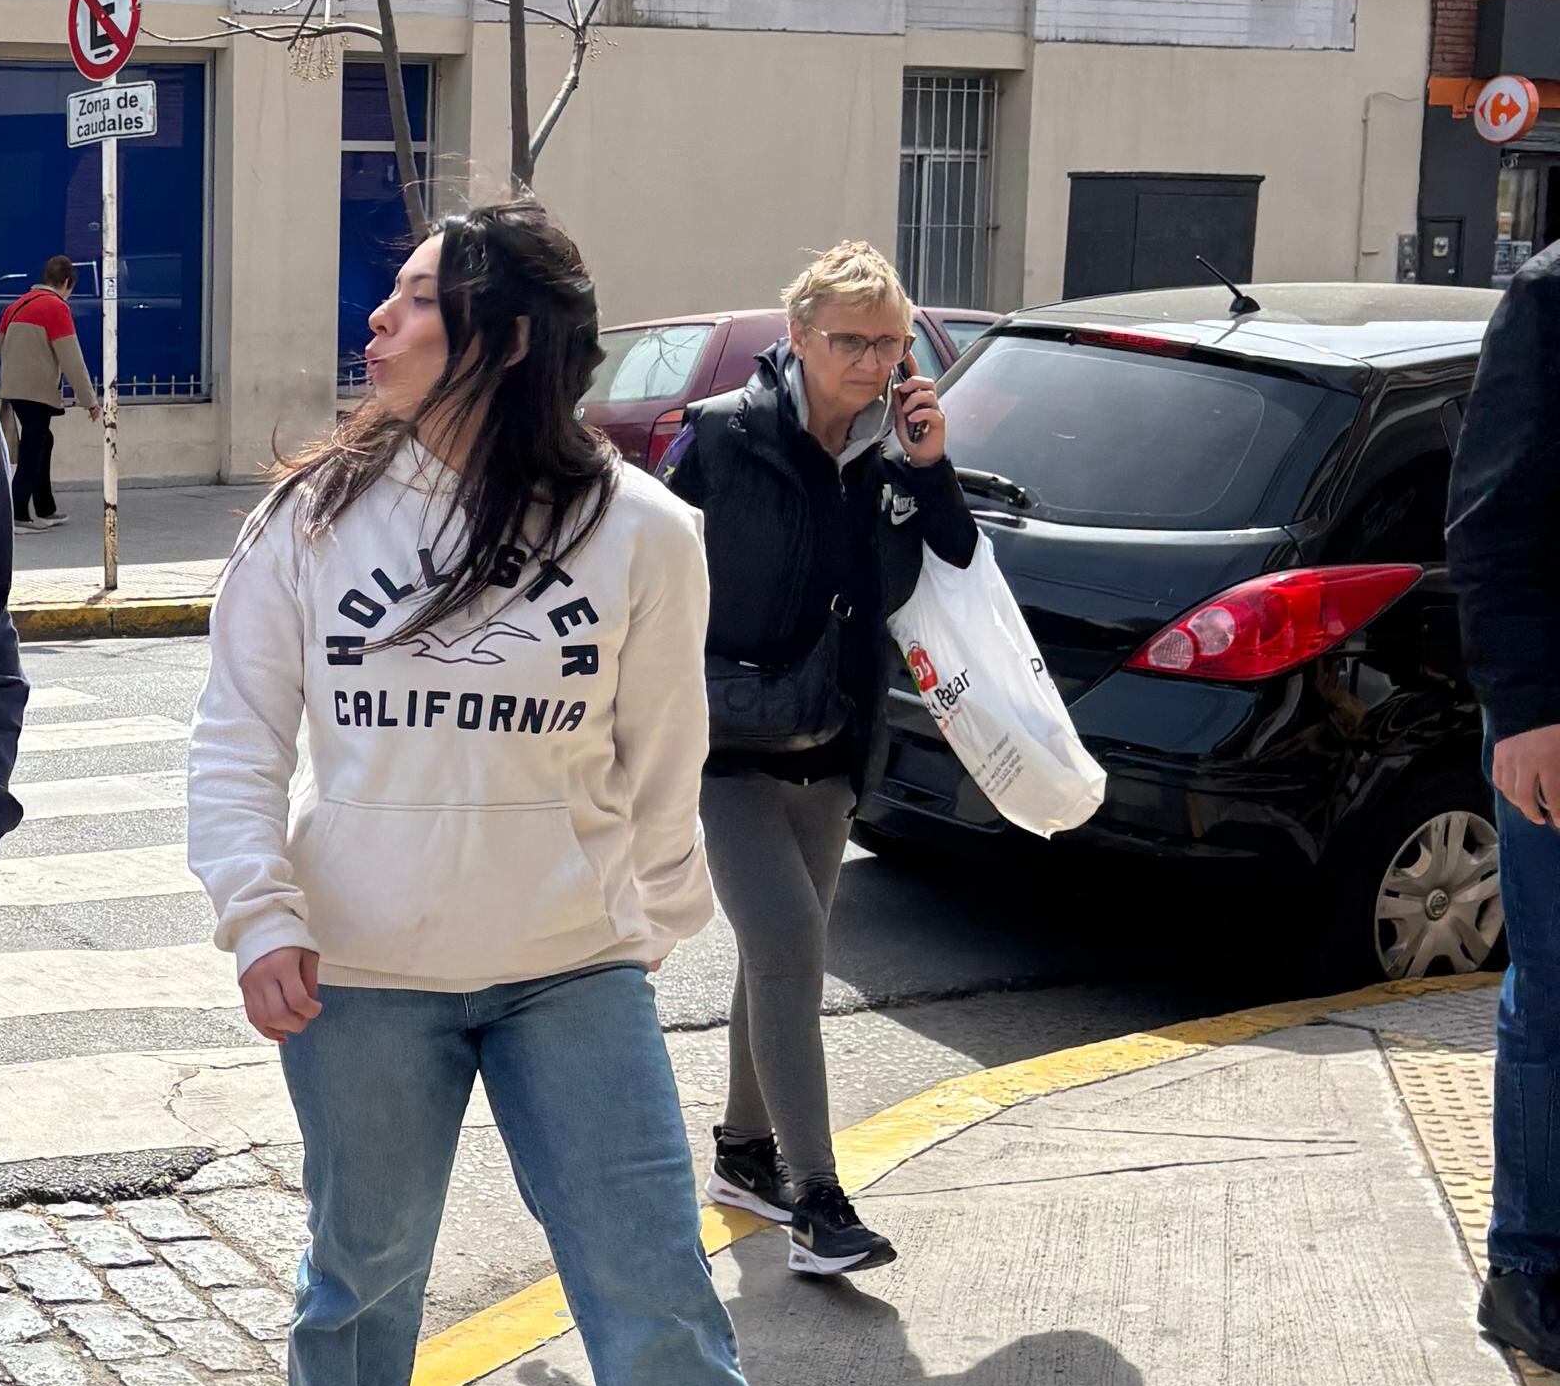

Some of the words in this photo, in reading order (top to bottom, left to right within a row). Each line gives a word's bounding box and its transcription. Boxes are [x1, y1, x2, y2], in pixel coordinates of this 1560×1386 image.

[78, 96, 110, 115] Zona
[116, 91, 139, 109] de
[76, 114, 144, 138] caudales
[326, 543, 599, 678] HOLLSTER
[333, 689, 587, 734] CALIFORNIA
